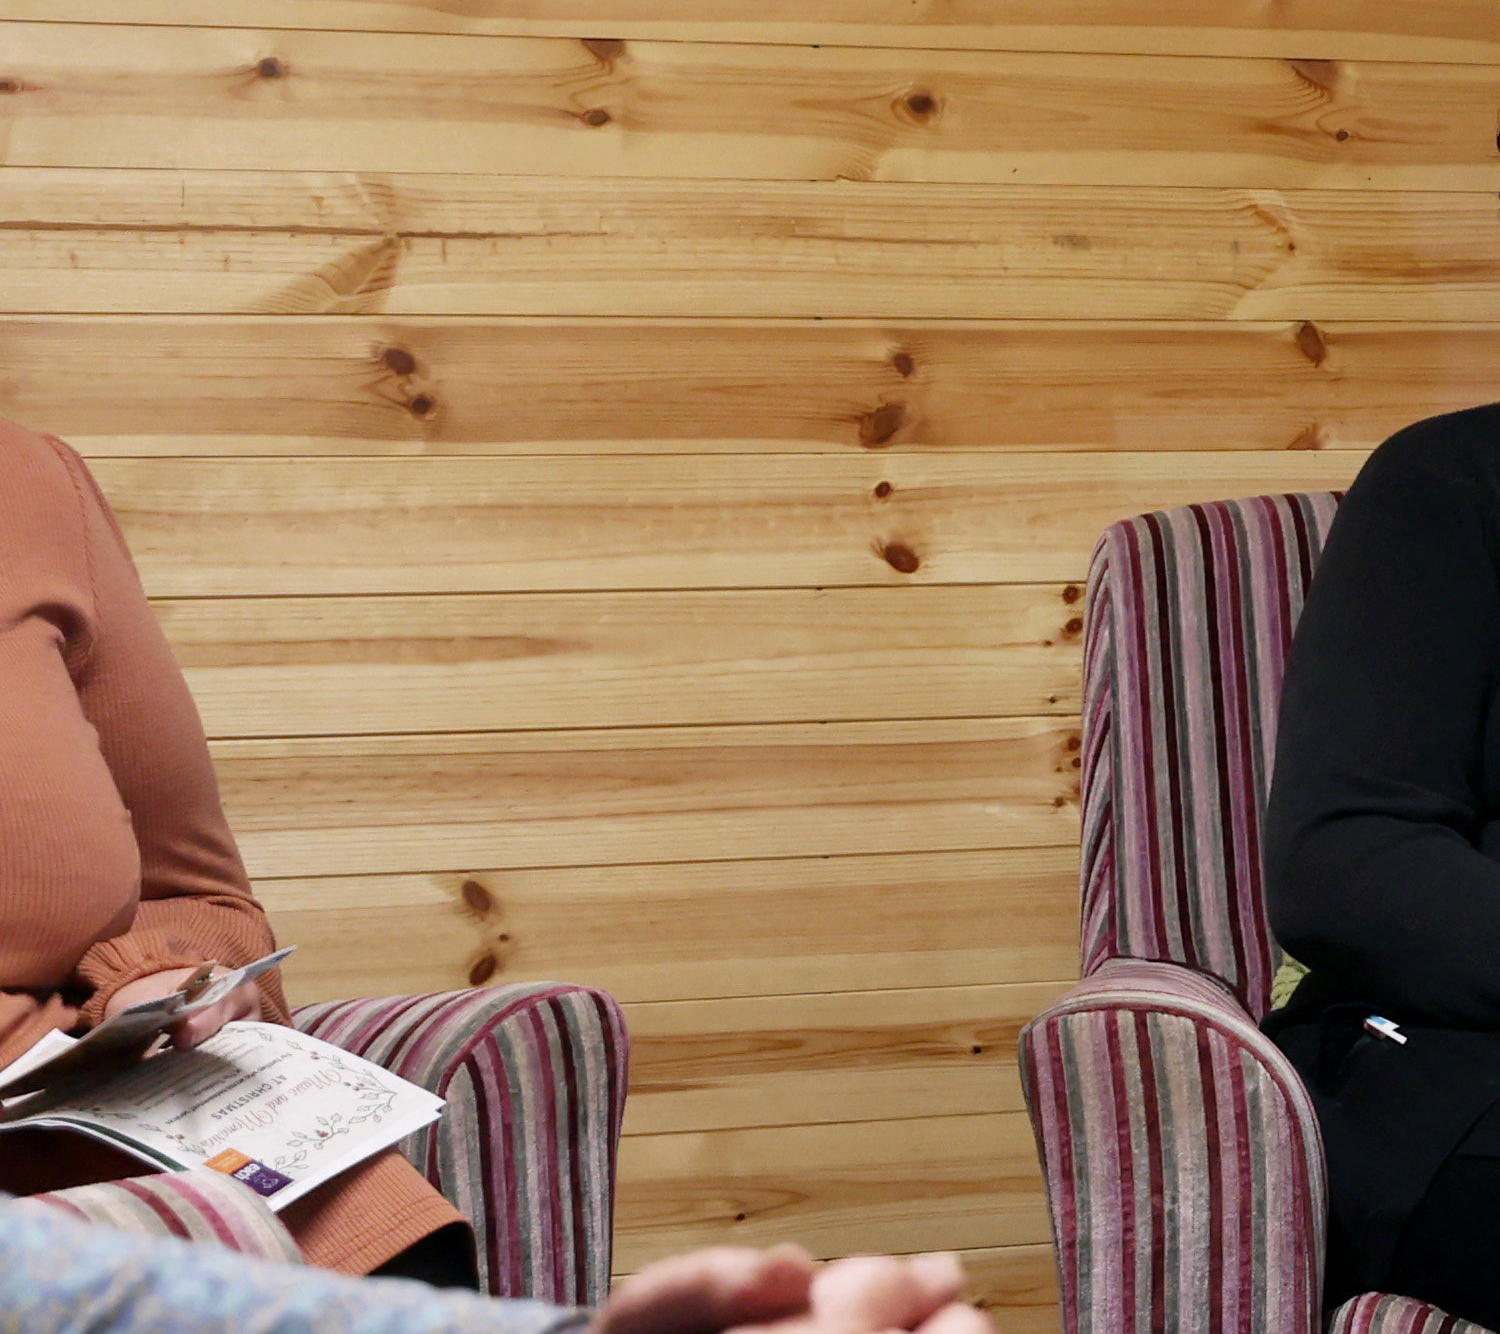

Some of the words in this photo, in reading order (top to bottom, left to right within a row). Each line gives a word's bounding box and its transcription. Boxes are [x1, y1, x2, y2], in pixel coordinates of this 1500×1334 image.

[272, 1073, 288, 1086] AT
[288, 1068, 342, 1097] Music
[211, 1082, 272, 1120] CHRISTMAS
[264, 1095, 289, 1115] and
[200, 1109, 274, 1147] Memories
[233, 1163, 260, 1180] each
